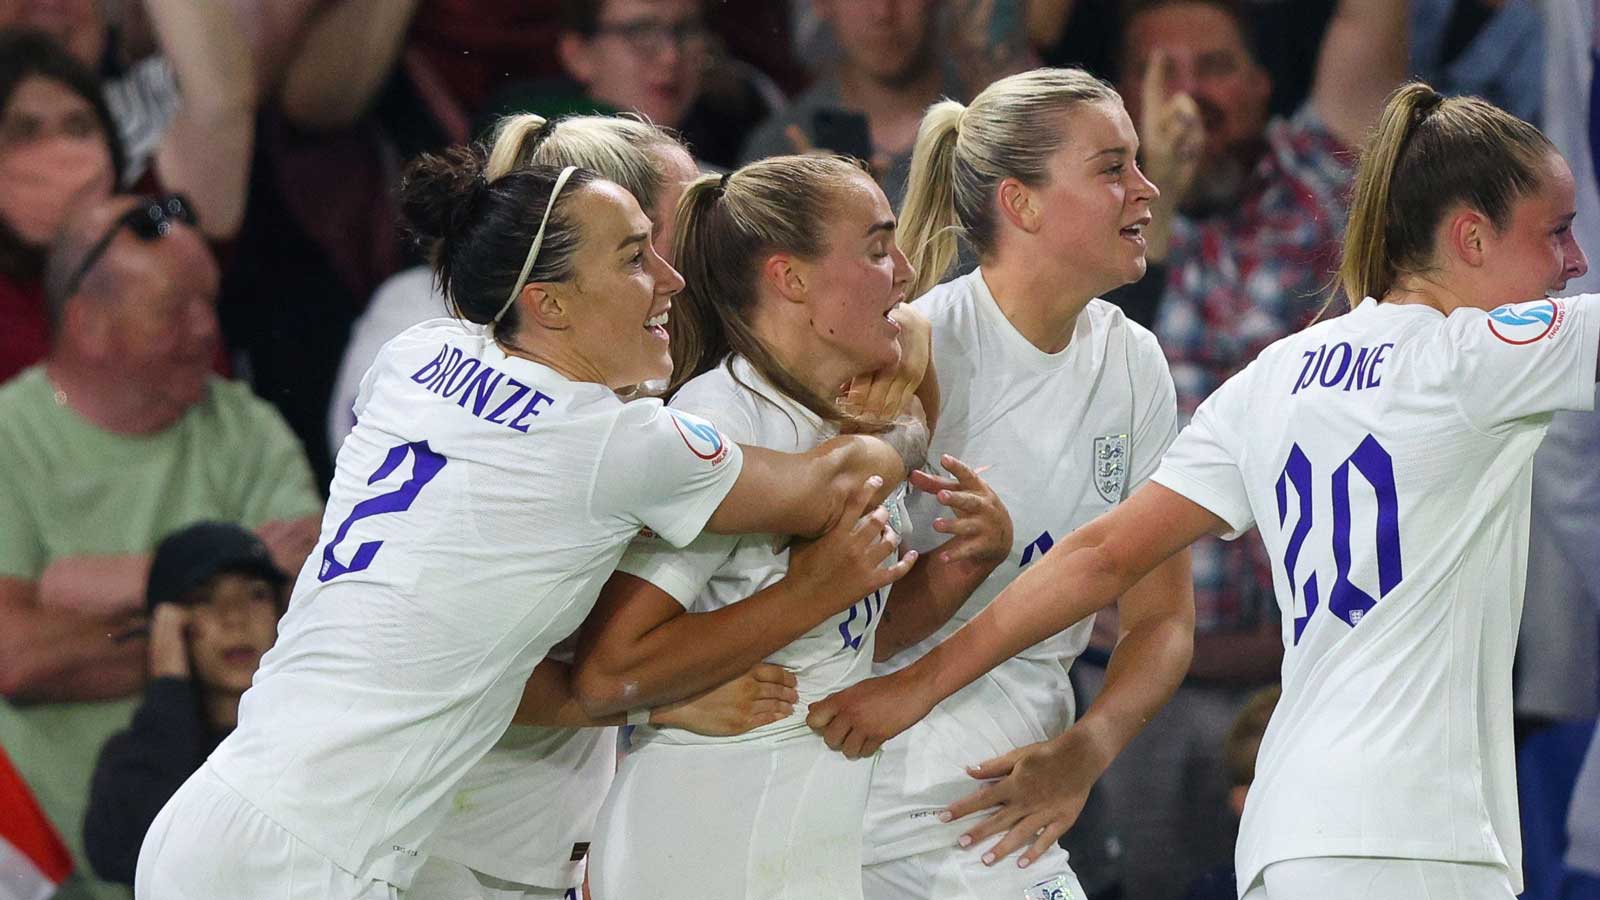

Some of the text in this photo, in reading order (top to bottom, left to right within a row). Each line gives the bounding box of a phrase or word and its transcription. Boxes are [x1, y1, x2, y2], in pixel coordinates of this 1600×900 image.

[410, 344, 555, 433] BRONZE
[318, 440, 448, 583] 2
[1275, 433, 1403, 647] 20
